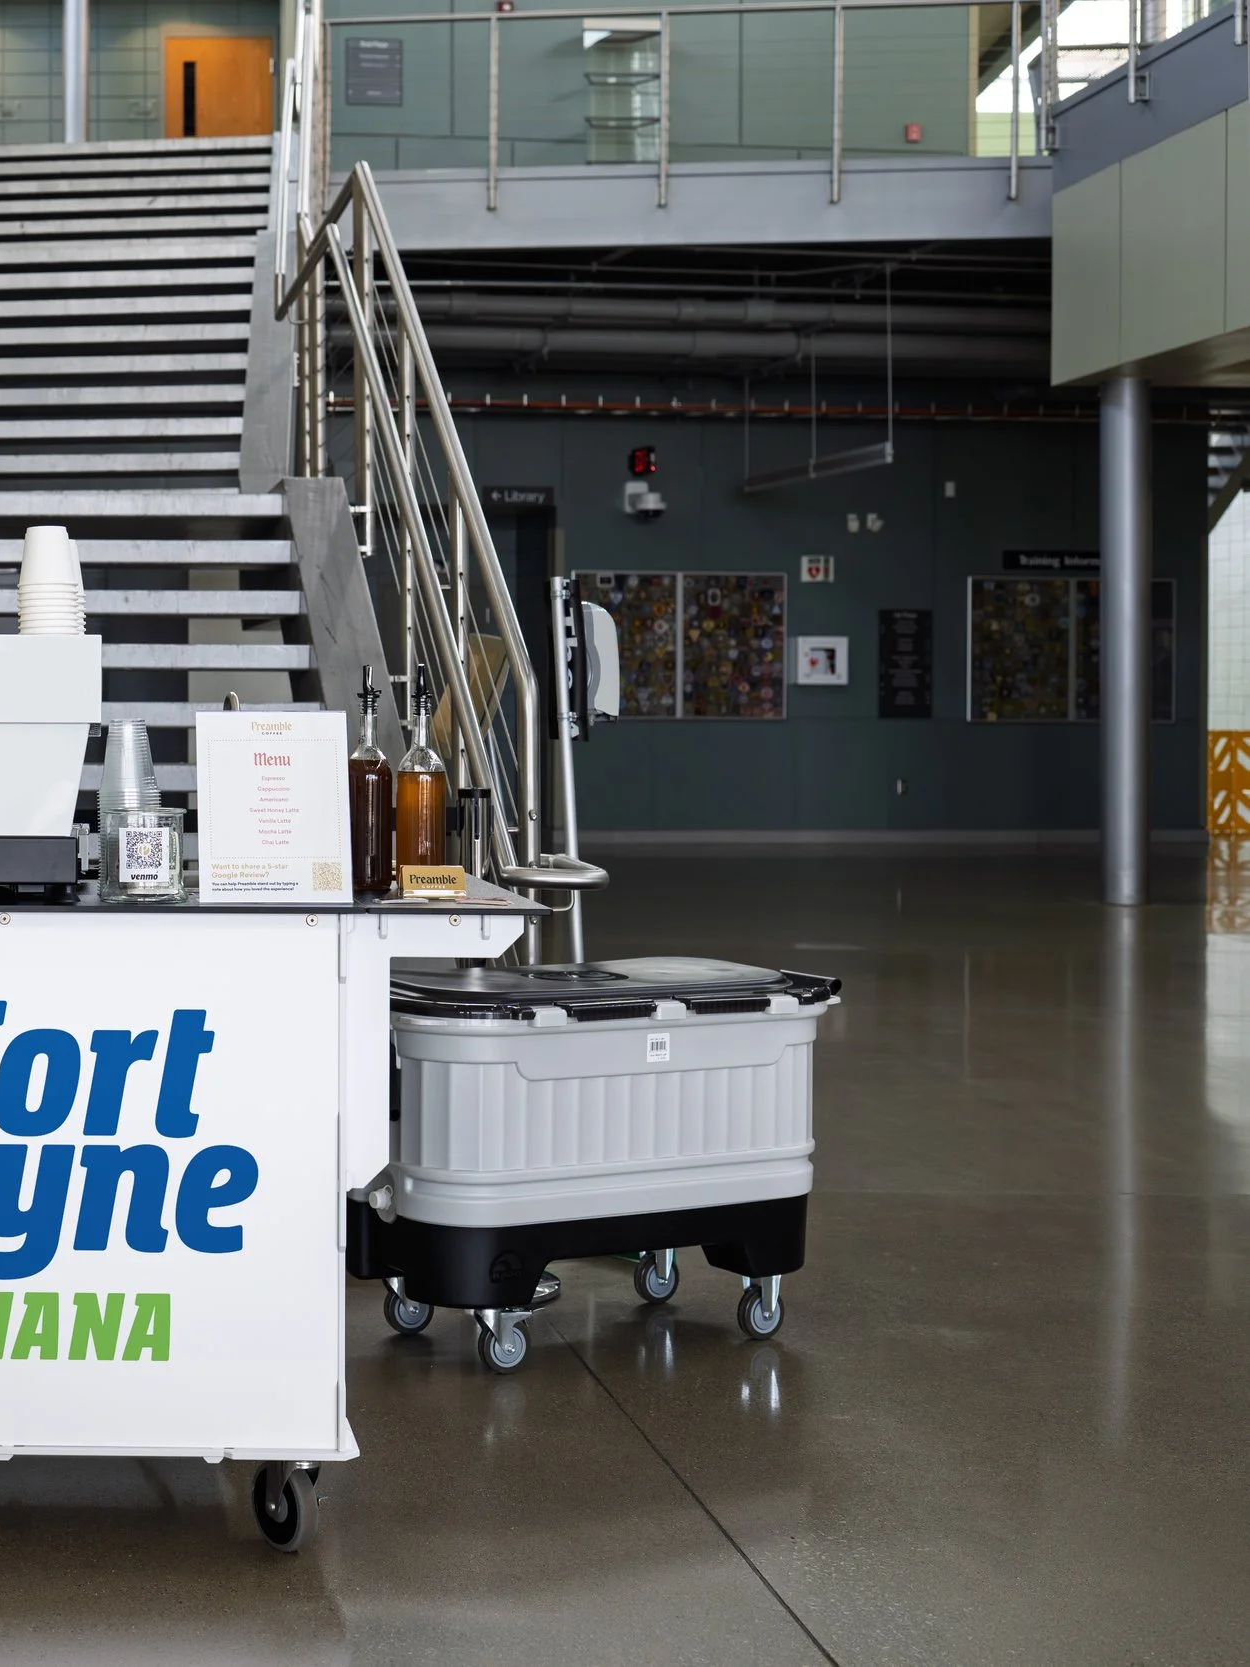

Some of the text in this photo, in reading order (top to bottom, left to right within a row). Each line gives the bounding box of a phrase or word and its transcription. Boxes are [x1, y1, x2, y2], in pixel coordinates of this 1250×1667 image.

[503, 489, 546, 505] Library
[251, 721, 292, 731] Preamble
[253, 752, 291, 766] Menu
[241, 862, 261, 870] share
[267, 862, 289, 870] 5-star
[211, 871, 270, 879] Google Review?
[410, 874, 458, 885] Preamble
